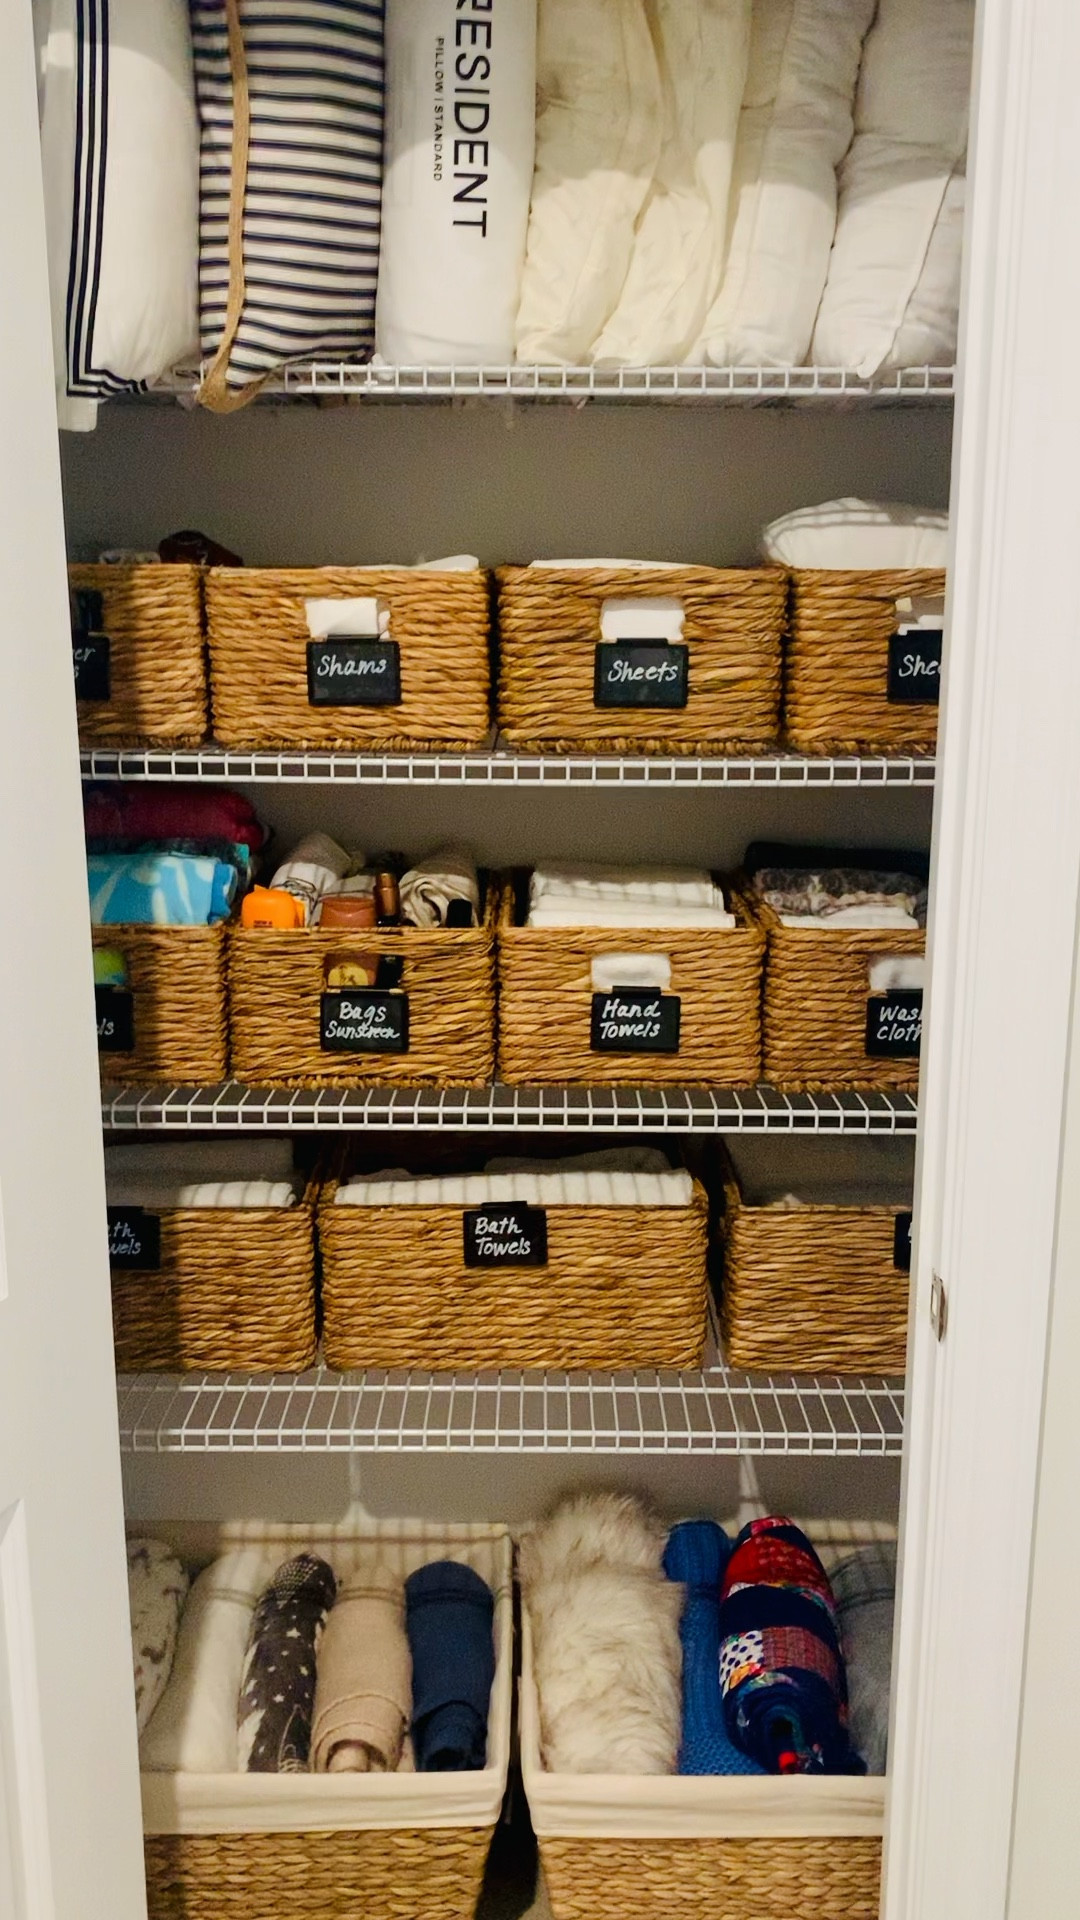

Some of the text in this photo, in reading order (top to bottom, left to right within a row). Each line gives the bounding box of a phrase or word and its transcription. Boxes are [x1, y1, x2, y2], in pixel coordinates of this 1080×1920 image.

[434, 36, 444, 93] PILLOW
[433, 105, 443, 181] STANDARD
[317, 654, 387, 677] Shams
[607, 659, 678, 682] Sheets
[899, 655, 941, 677] She
[339, 1001, 387, 1026] Bags
[602, 998, 661, 1018] Hand
[880, 1005, 922, 1022] Was
[325, 1020, 401, 1039] Sunscreen
[600, 1021, 660, 1039] Towels
[475, 1217, 523, 1235] Bath
[475, 1237, 531, 1257] Towels
